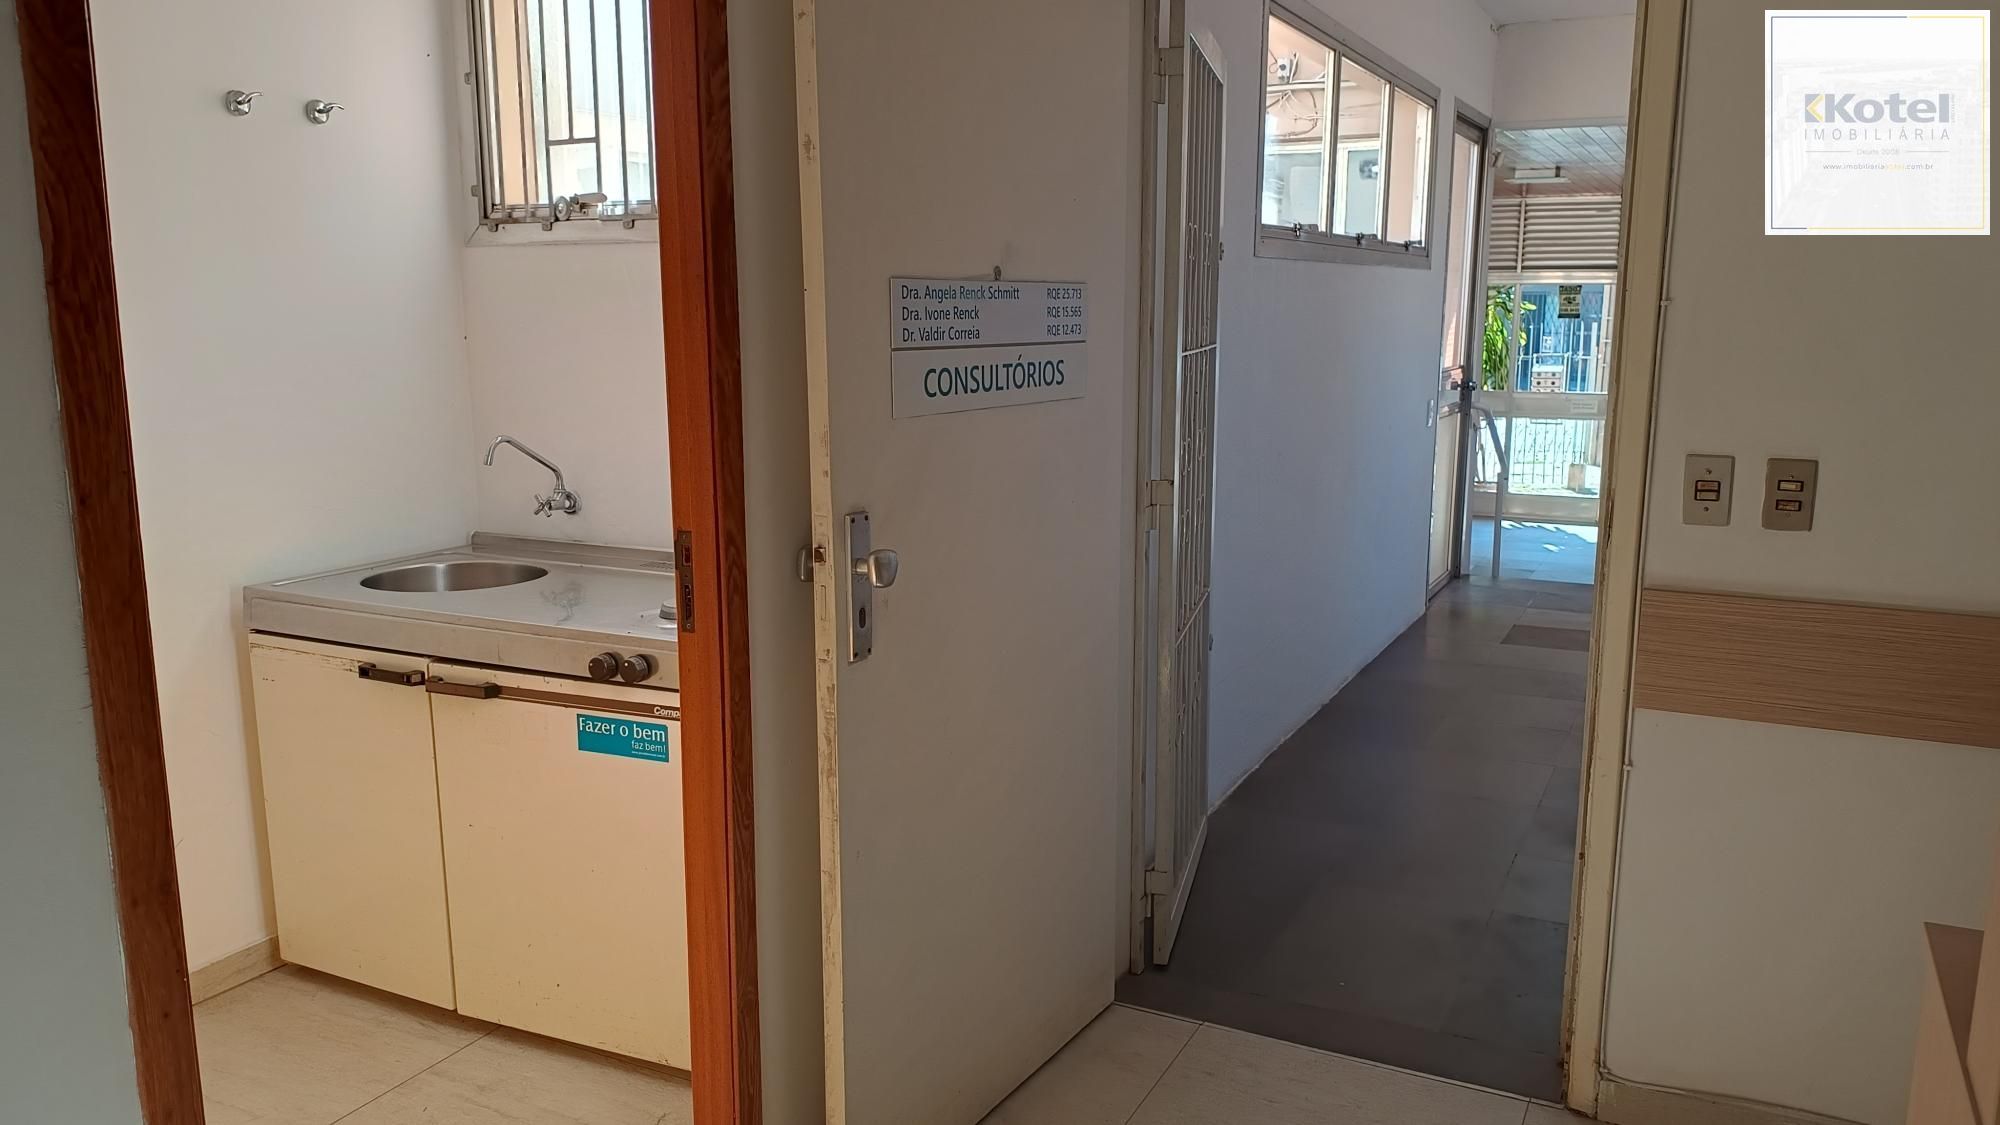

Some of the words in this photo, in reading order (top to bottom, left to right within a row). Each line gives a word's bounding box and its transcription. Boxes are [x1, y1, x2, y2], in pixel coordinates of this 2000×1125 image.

[901, 285, 922, 300] Dra.
[924, 286, 957, 303] Angela
[959, 285, 986, 300] Renck
[988, 286, 1020, 300] Schmitt
[1046, 287, 1062, 300] RQE
[1062, 287, 1082, 299] 25.713
[902, 306, 922, 321] Dra.
[924, 307, 951, 320] Ivone
[953, 306, 980, 320] Renck
[1046, 306, 1061, 318] RQE
[1062, 306, 1082, 318] 15.565
[902, 328, 916, 342] Dr.
[918, 327, 946, 341] Valdir
[948, 326, 980, 340] Correia
[1046, 324, 1061, 336] RQE
[1062, 324, 1082, 336] 12.473
[924, 354, 1064, 398] CONSULTÓRIOS
[579, 717, 615, 735] Fazer
[619, 725, 629, 737] o
[633, 723, 665, 742] bem
[631, 740, 643, 750] faz
[645, 742, 666, 753] bem!
